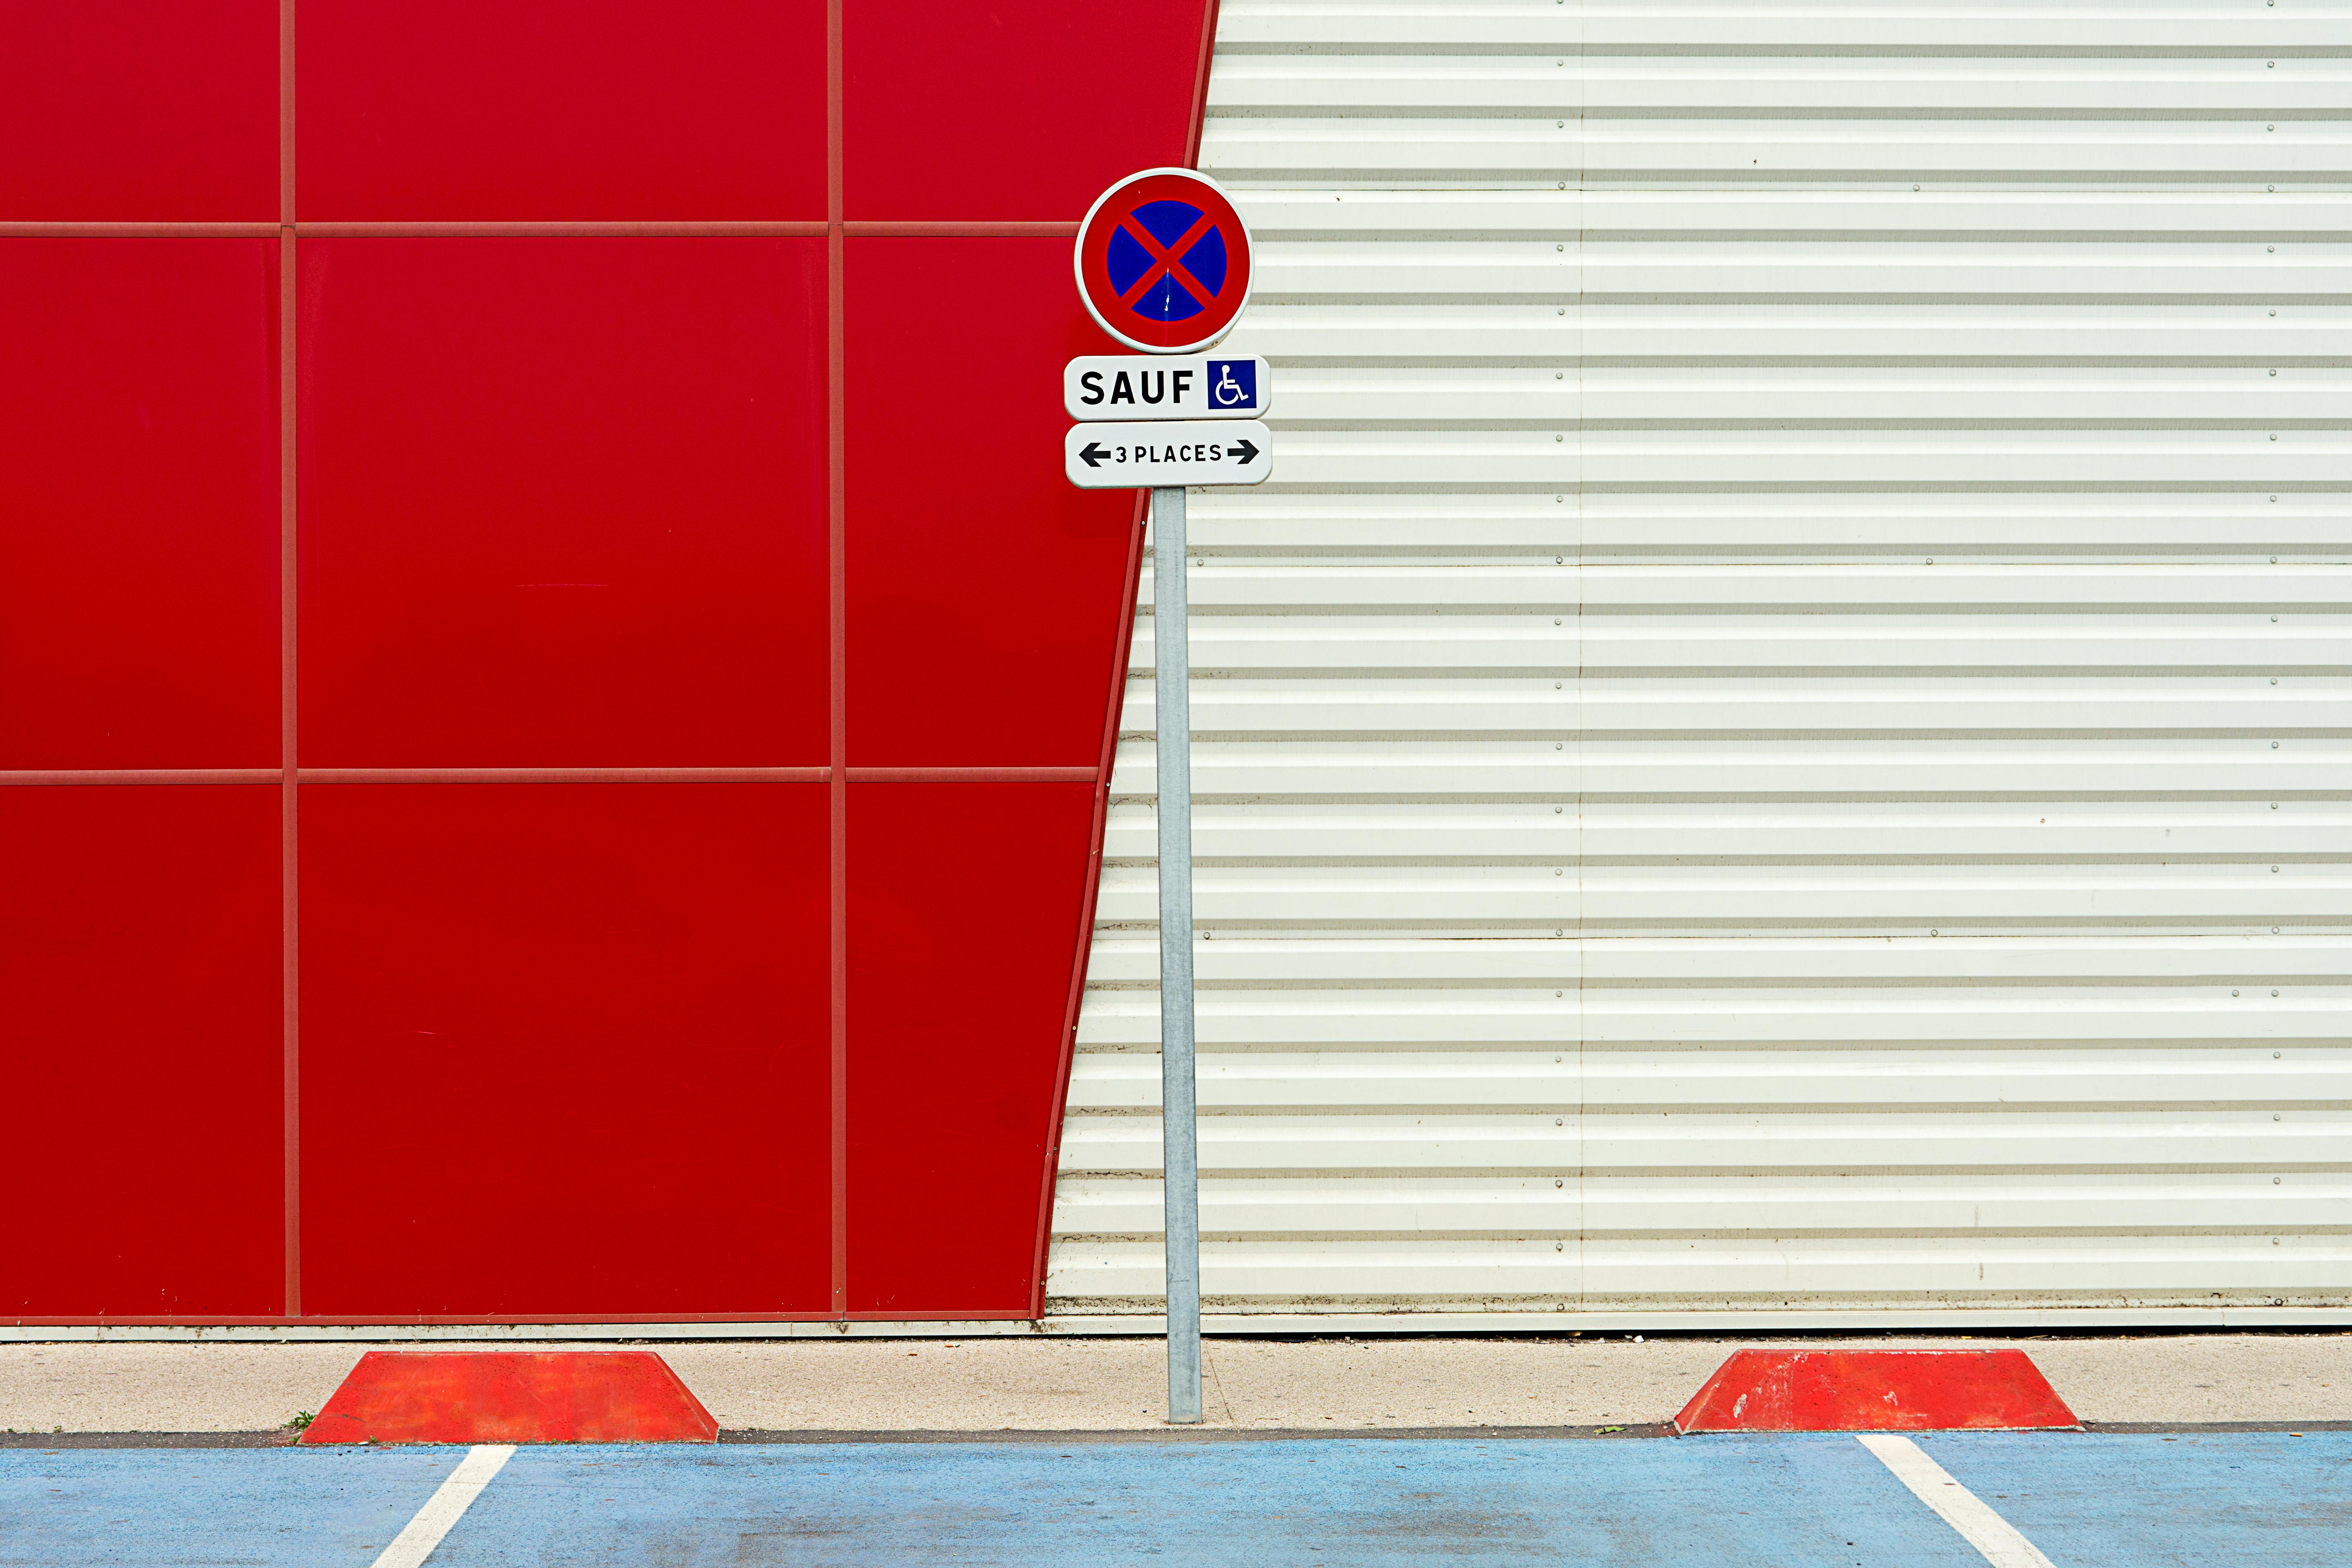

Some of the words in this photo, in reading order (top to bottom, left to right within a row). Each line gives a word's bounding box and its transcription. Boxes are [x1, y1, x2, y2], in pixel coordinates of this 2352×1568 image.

[1080, 370, 1193, 405] SAUF
[1116, 446, 1127, 463] 3
[1135, 444, 1222, 463] PLACES
